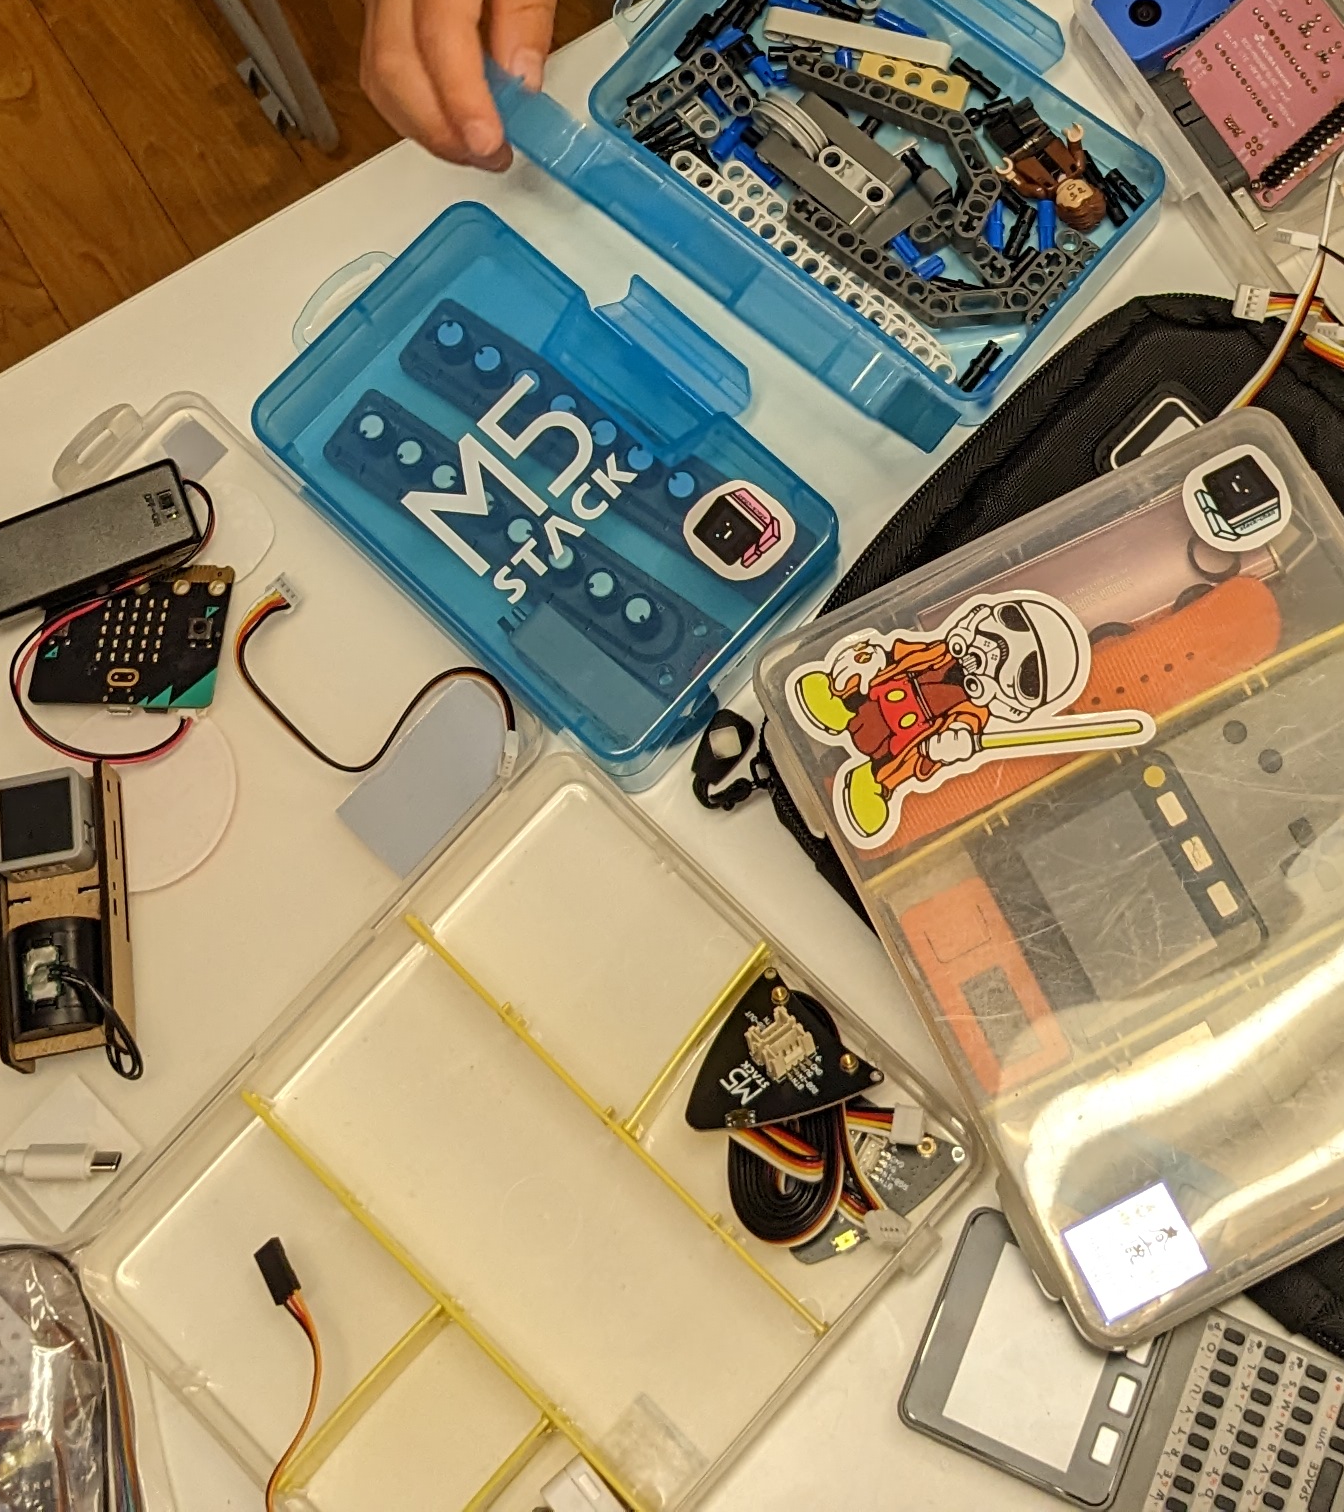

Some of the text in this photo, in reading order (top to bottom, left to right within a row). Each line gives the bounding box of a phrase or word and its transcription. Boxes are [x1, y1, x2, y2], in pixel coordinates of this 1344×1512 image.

[402, 373, 594, 578] M5
[493, 452, 639, 605] STACK
[739, 1059, 771, 1089] STACK
[719, 1067, 763, 1105] M5
[1214, 1322, 1223, 1331] P
[1241, 1383, 1250, 1392] K
[1281, 1400, 1292, 1412] M
[1226, 1425, 1236, 1435] H
[1275, 1422, 1284, 1432] N
[1171, 1449, 1179, 1458] R
[1220, 1445, 1229, 1455] G
[1268, 1444, 1277, 1453] B
[1165, 1470, 1173, 1479] E
[1300, 1462, 1319, 1501] SPACE
[1206, 1489, 1214, 1498] D
